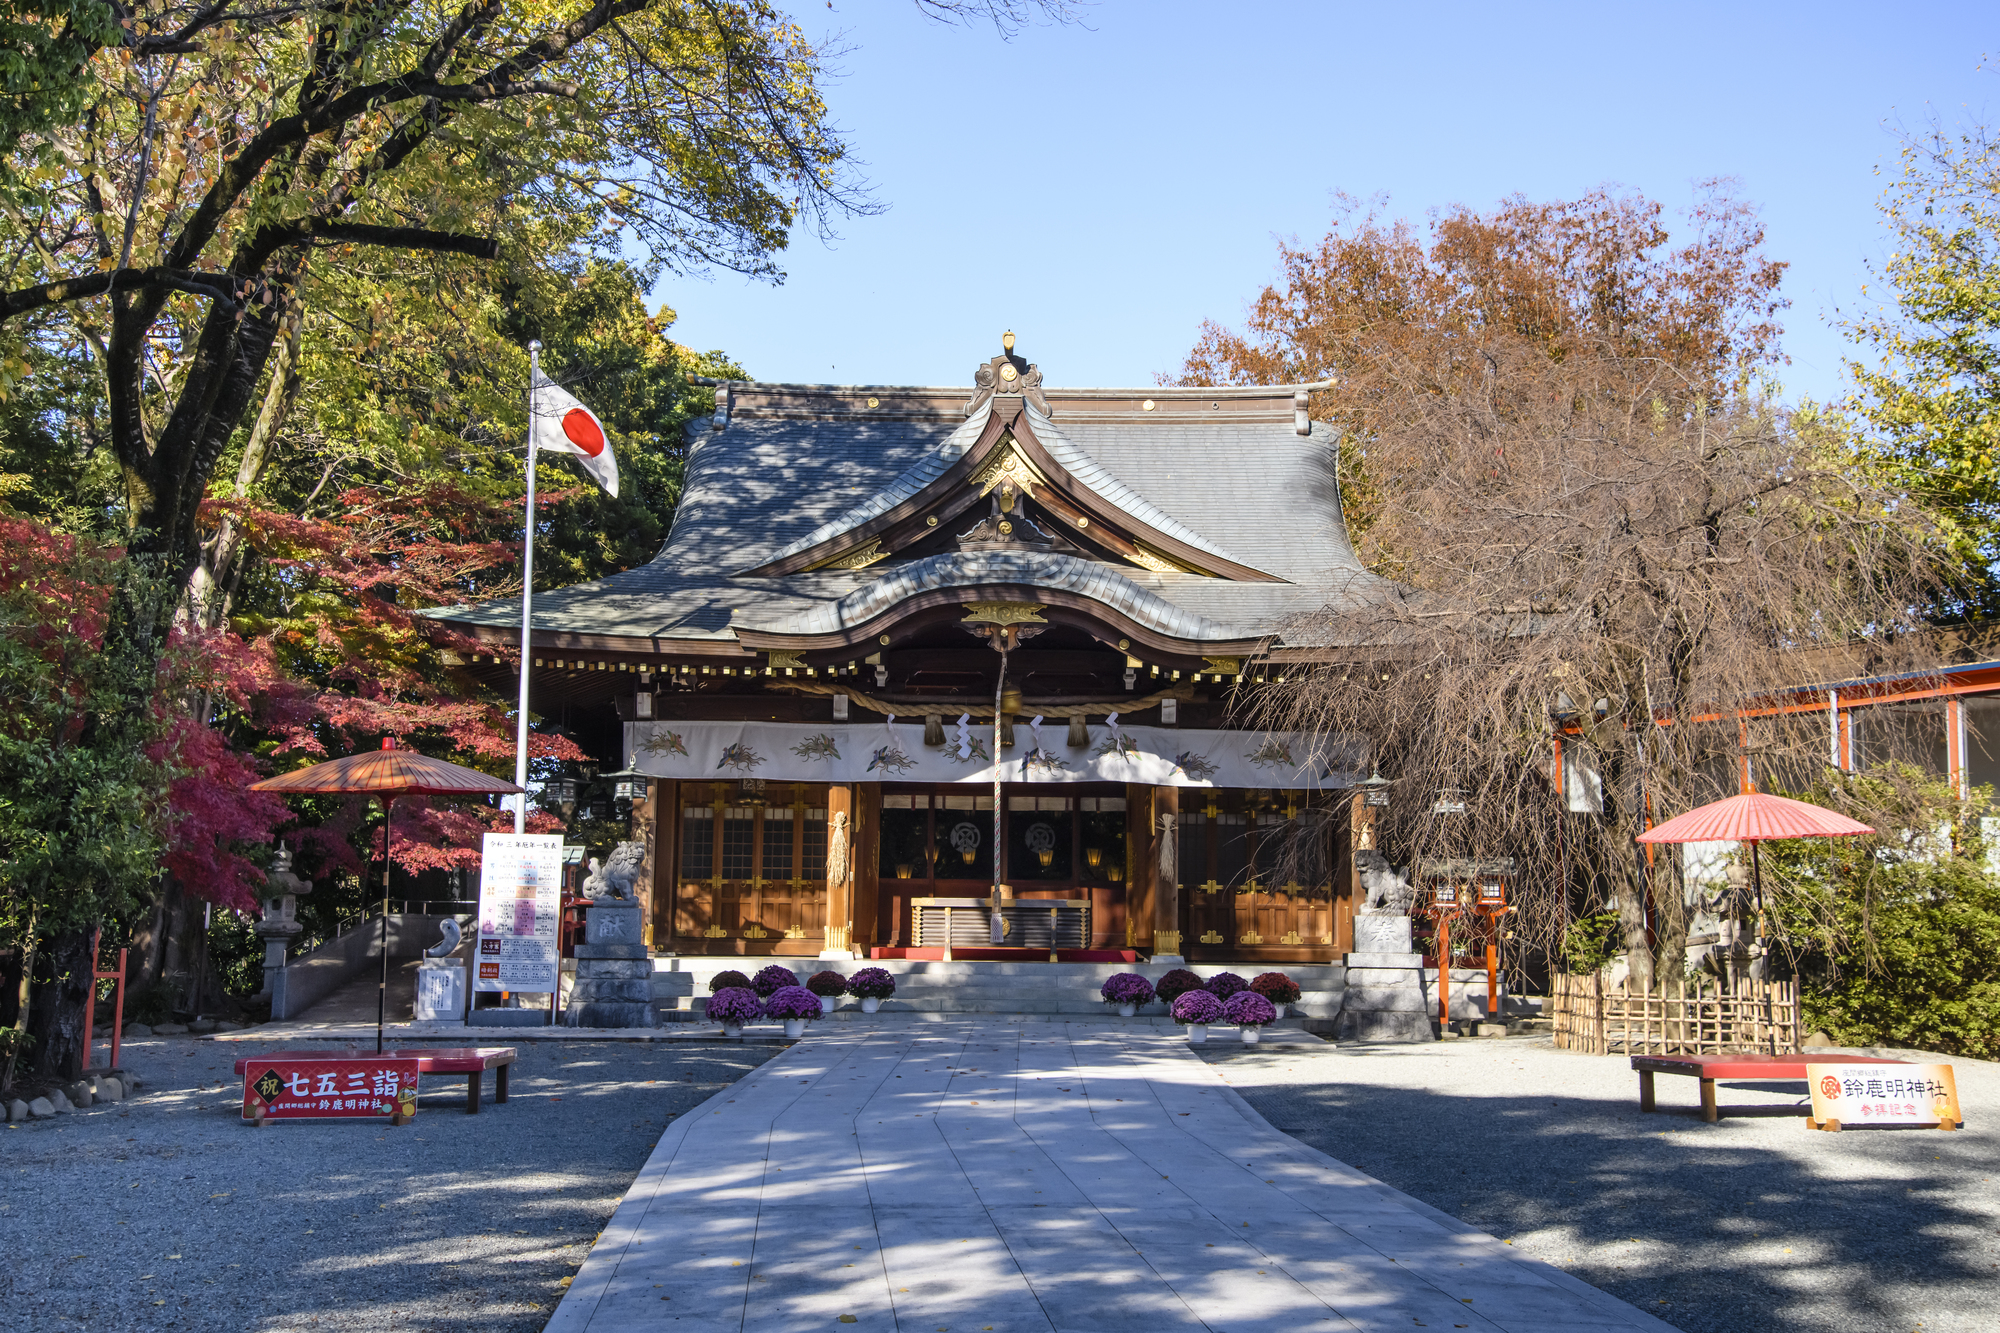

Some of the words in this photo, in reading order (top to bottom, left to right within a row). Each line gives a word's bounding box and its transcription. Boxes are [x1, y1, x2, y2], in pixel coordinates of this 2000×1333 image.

[260, 1076, 279, 1096] 祝
[283, 1070, 400, 1098] 七五三詣
[1843, 1078, 1948, 1099] 鈴鹿明神社
[318, 1098, 383, 1111] 鈴鹿明神社
[1860, 1103, 1918, 1116] 参拝記念
